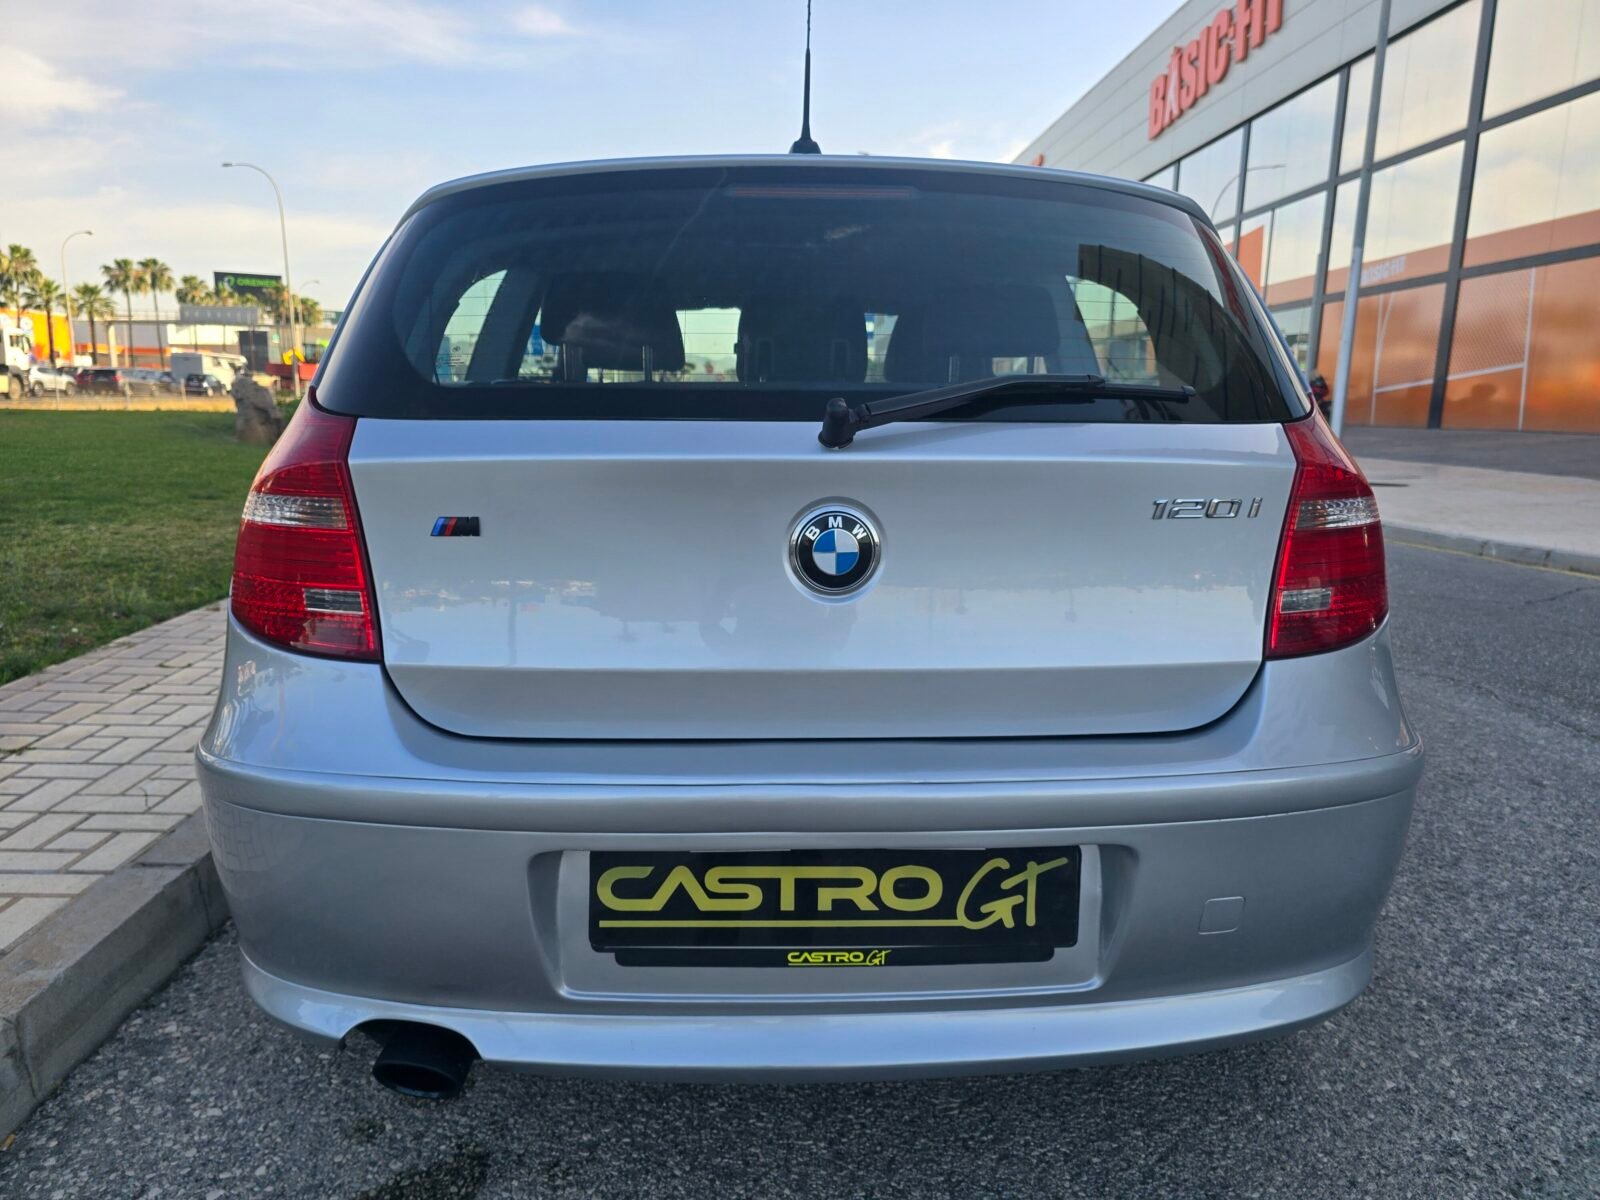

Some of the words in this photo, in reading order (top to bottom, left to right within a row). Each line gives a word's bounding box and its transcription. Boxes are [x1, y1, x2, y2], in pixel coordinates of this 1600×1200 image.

[1151, 497, 1263, 520] 120i
[805, 516, 867, 541] BMW
[597, 865, 943, 911] CASTRO
[957, 858, 1068, 929] GT
[788, 952, 864, 962] CASTRO
[866, 950, 892, 965] GT
